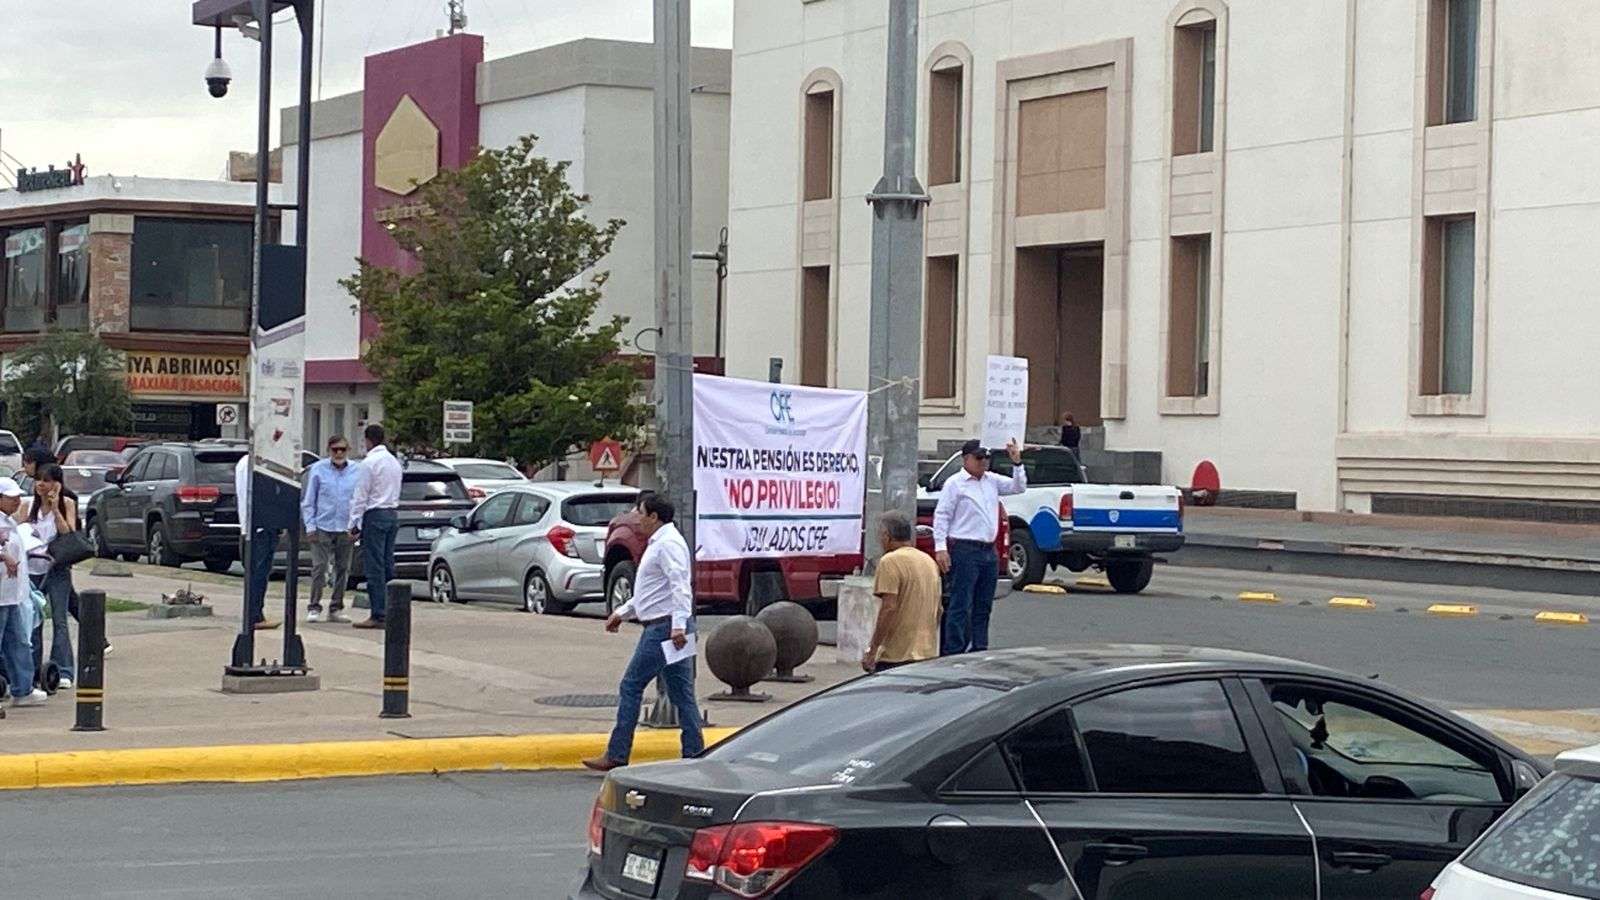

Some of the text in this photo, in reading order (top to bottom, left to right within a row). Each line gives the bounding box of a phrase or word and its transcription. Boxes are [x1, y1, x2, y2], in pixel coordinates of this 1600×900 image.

[158, 357, 240, 376] ABRIMOS!
[752, 444, 801, 472] PENSIÓN
[756, 479, 841, 509] PRIVILEGIO!
